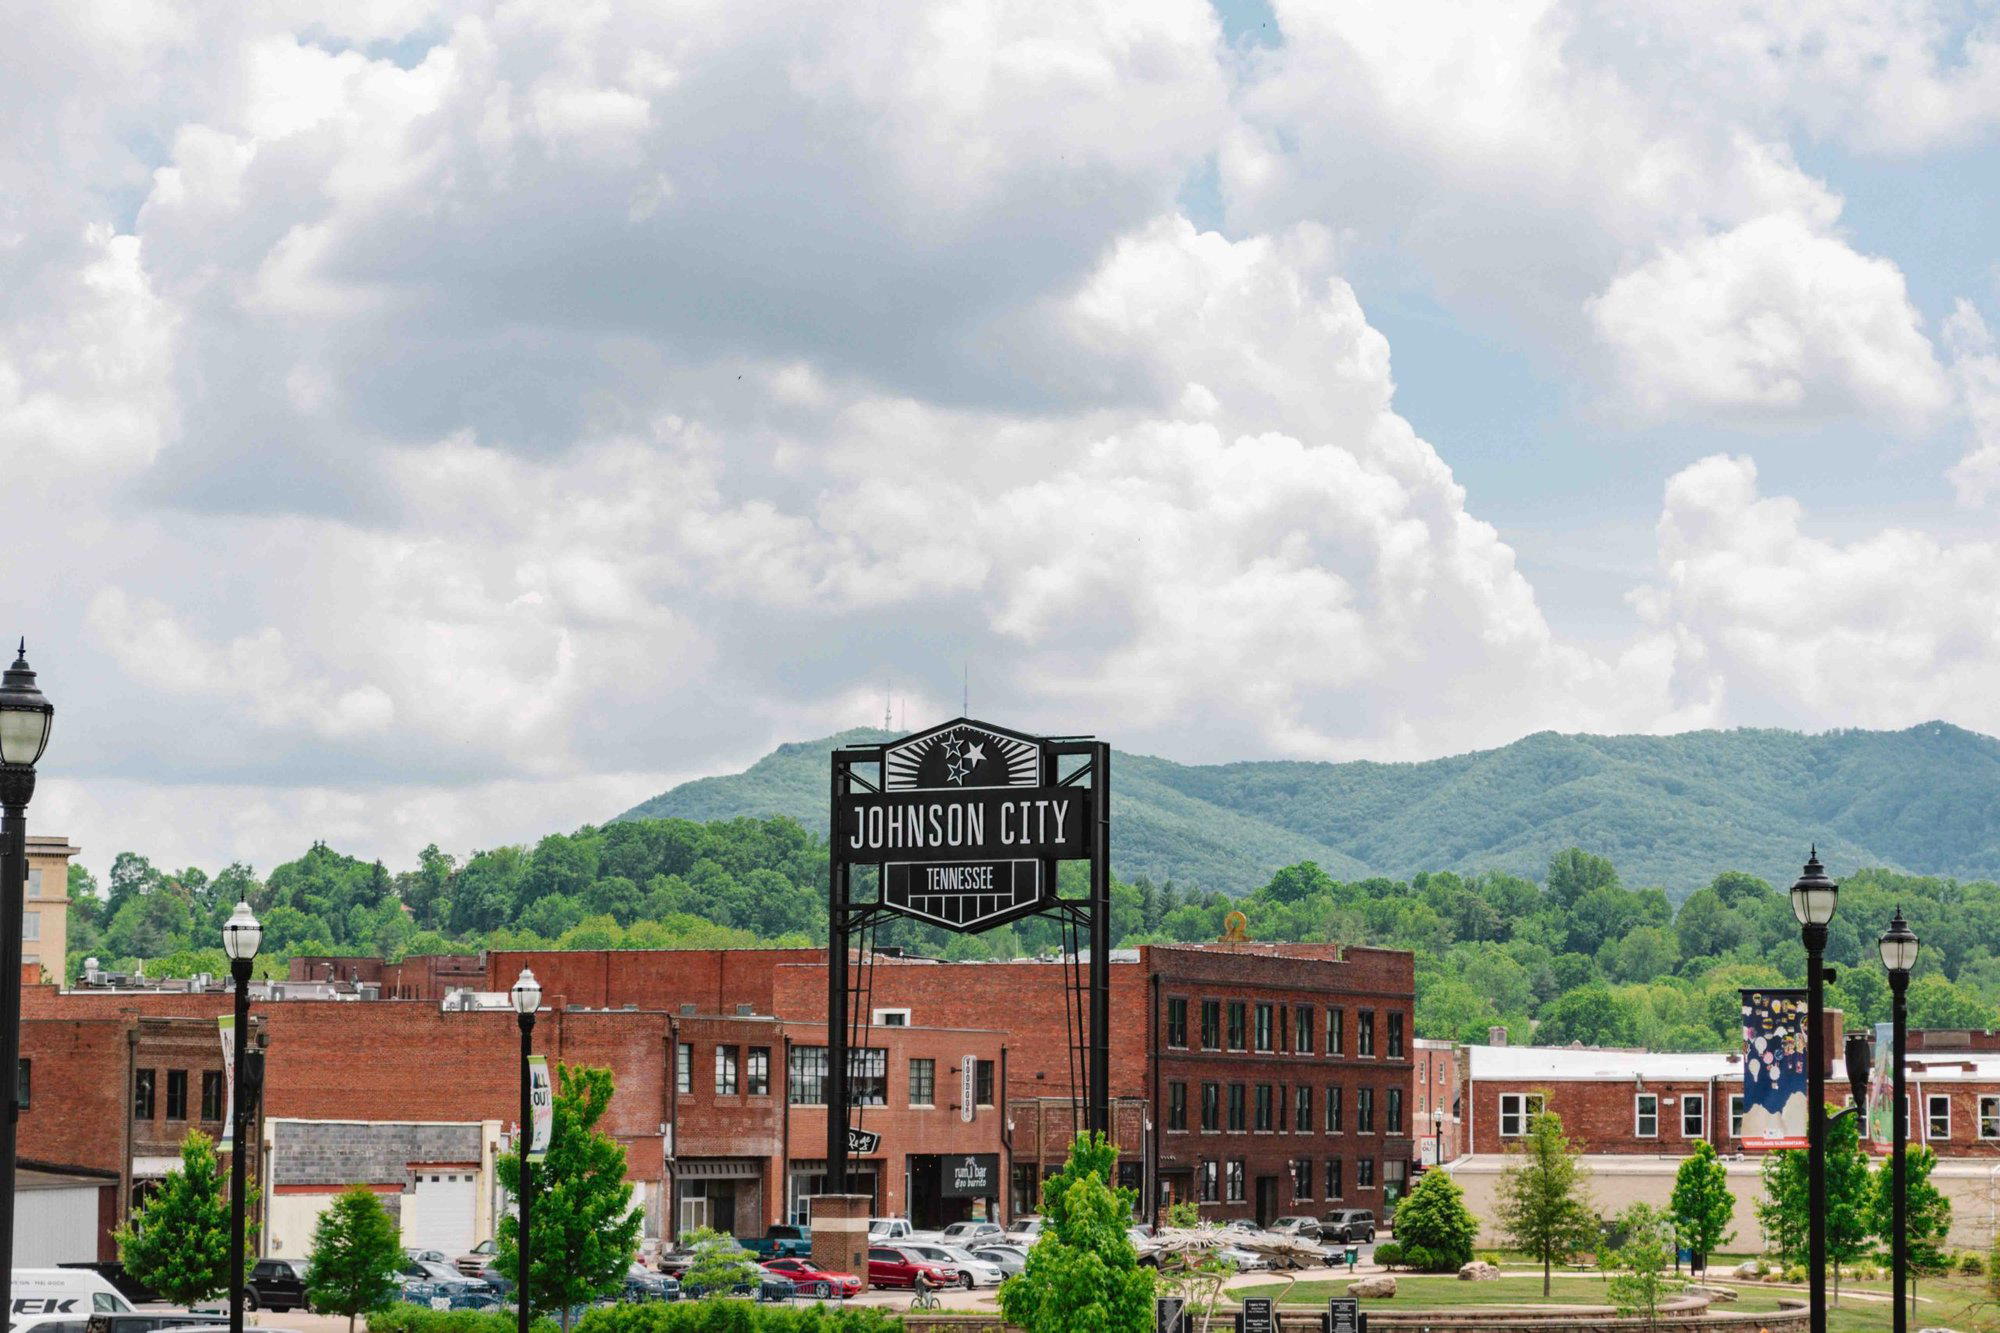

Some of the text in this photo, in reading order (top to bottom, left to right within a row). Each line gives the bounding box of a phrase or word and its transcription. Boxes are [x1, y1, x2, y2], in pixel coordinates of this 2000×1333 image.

[850, 800, 1069, 849] JOHNSON CITY
[926, 866, 994, 891] TENNESSEE
[954, 1163, 987, 1179] rum bar
[967, 1177, 987, 1187] burrito
[10, 1298, 80, 1315] EK
